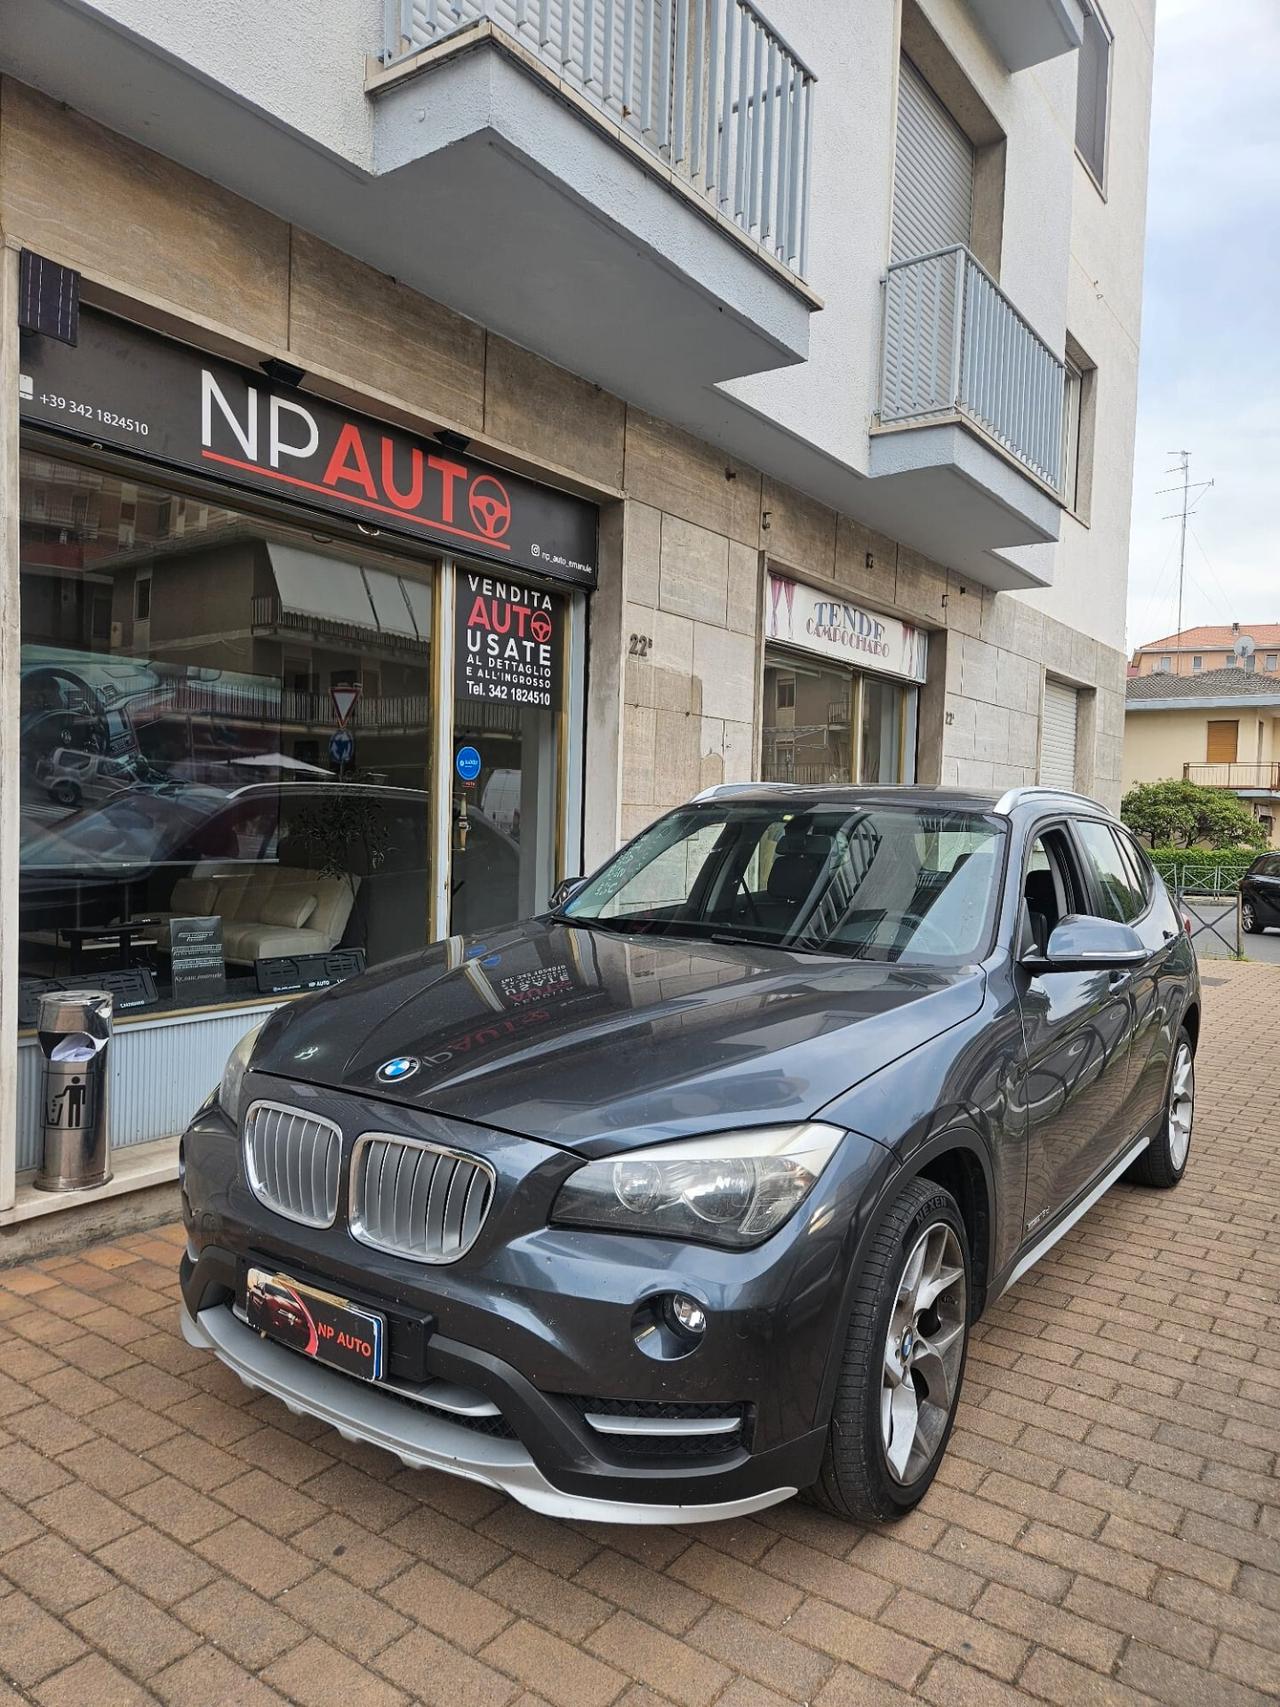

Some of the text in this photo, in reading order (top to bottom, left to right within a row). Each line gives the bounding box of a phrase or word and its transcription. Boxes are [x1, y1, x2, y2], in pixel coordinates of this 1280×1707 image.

[39, 393, 149, 436] +39 342 1824510
[467, 574, 553, 611] VENDITA
[467, 595, 552, 643] AUTO
[466, 653, 552, 678] AL DETTAGLIO
[467, 629, 552, 667] USATE
[465, 666, 552, 689] E ALL'INGROSSO
[466, 680, 551, 706] Tel. 342 1824510
[915, 1195, 948, 1224] NEXEN
[317, 1322, 372, 1358] NP AUTO
